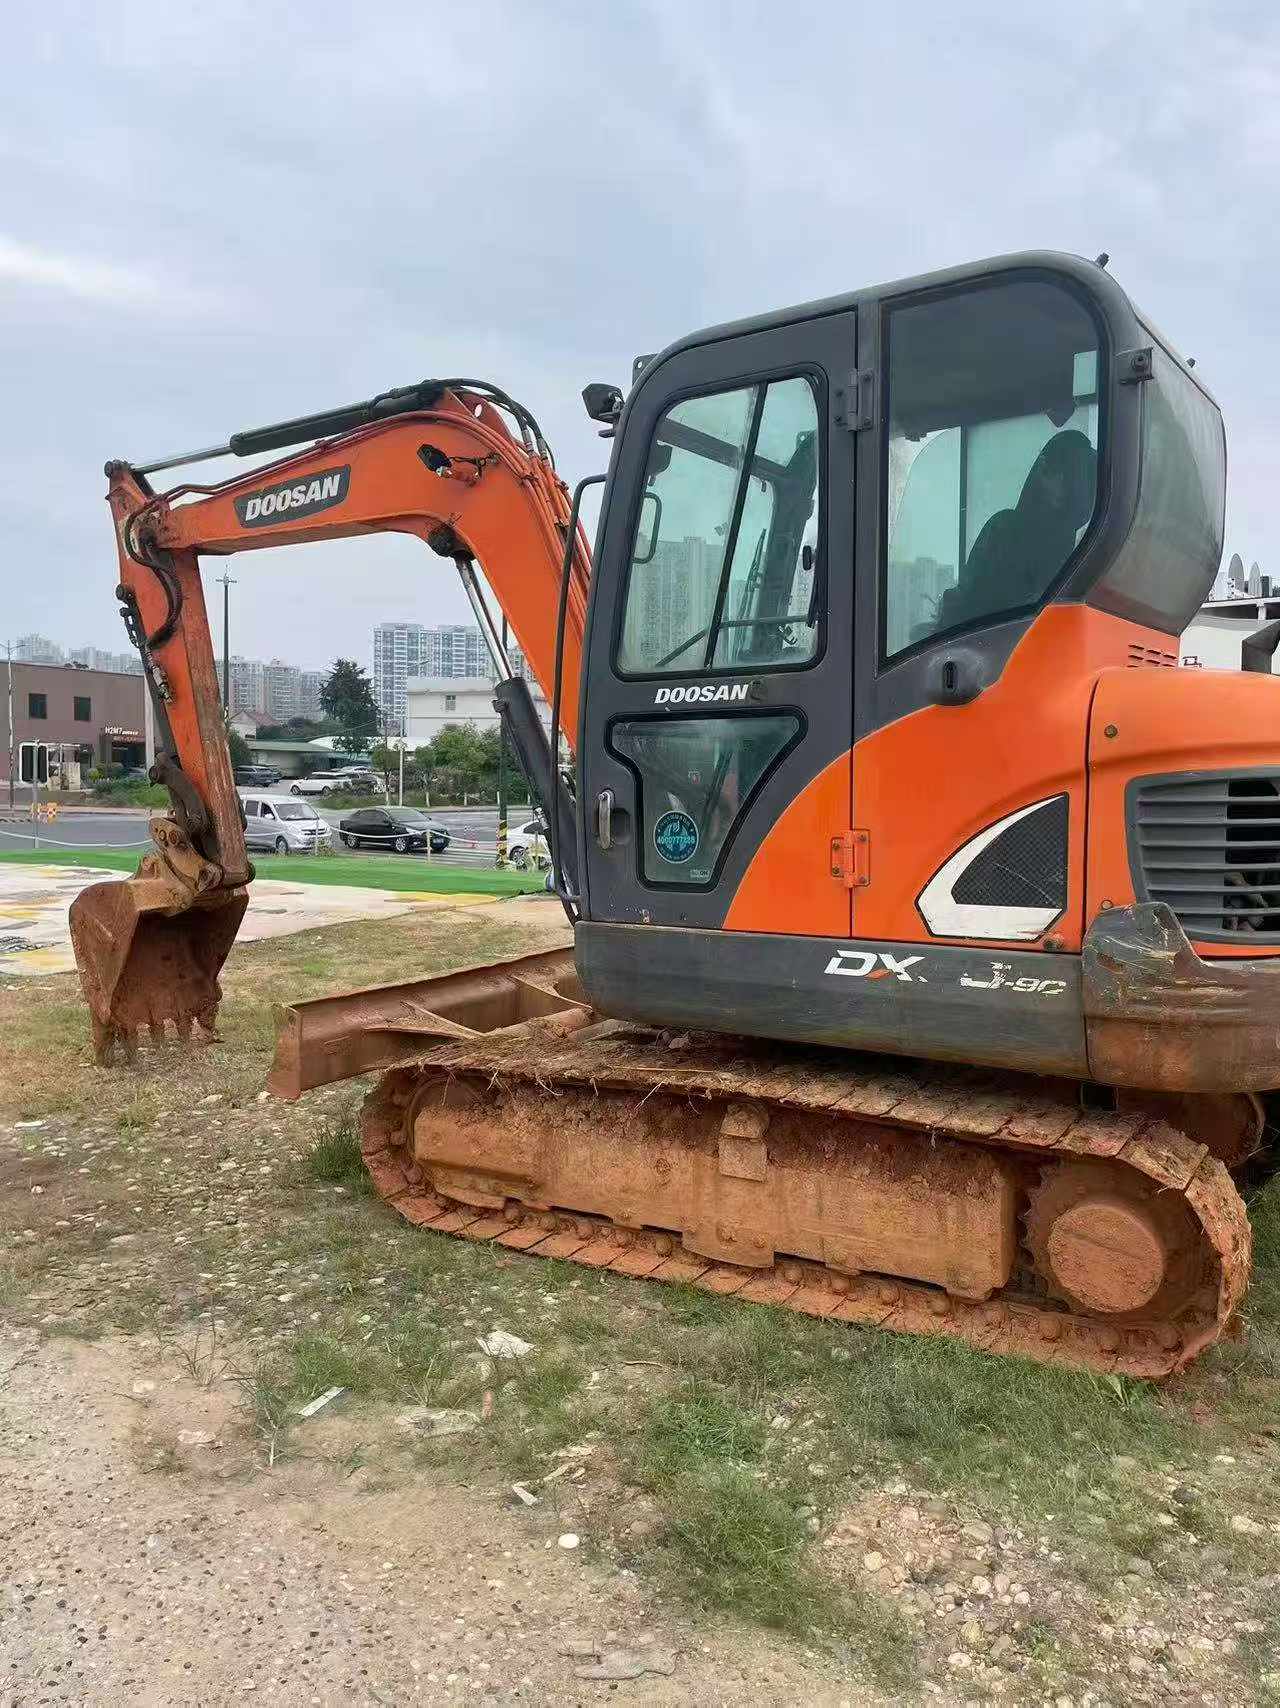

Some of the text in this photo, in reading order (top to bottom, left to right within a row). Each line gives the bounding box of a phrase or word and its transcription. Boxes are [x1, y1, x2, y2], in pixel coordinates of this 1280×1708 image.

[245, 474, 341, 521] DOOSAN
[654, 684, 749, 704] DOOSAN
[824, 950, 928, 982] DX
